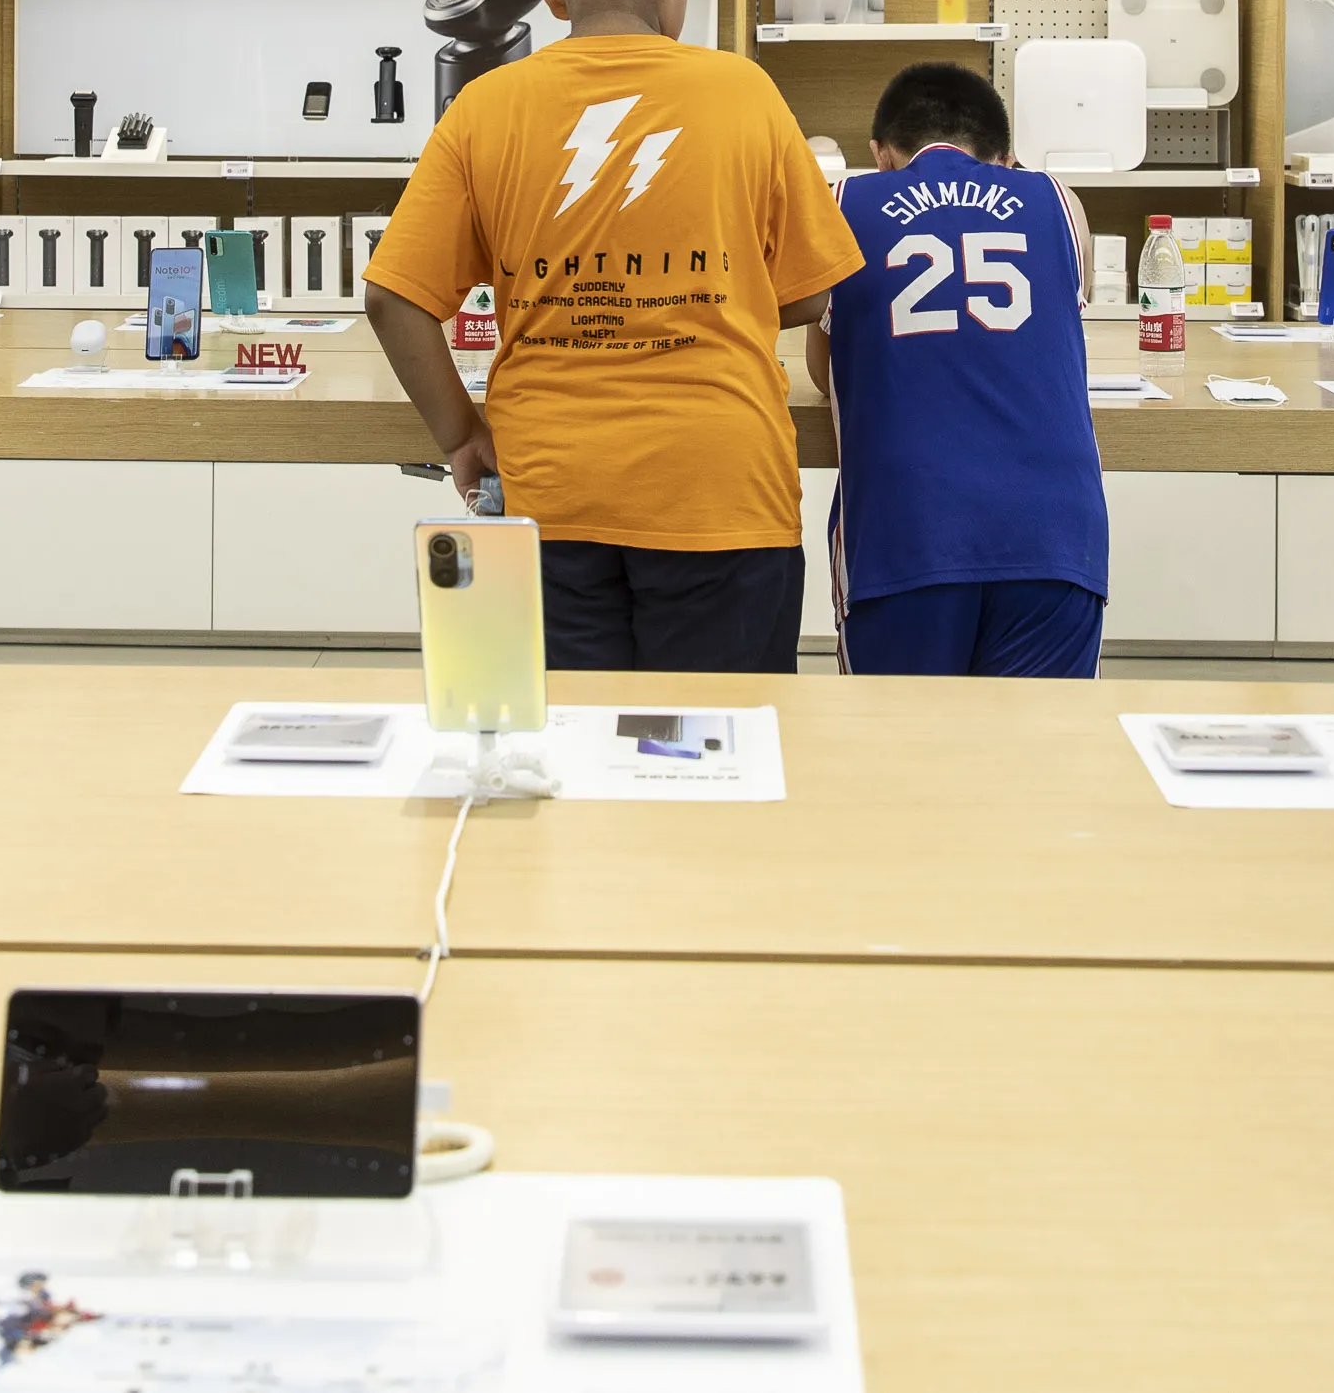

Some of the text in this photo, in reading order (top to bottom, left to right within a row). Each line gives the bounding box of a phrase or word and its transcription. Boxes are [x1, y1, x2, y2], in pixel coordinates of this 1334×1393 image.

[882, 181, 1024, 225] SIMMONS
[572, 281, 625, 293] SUDDENLY
[886, 232, 1032, 337] 25
[577, 295, 632, 308] CRACKLED
[636, 294, 687, 308] THROUGH
[690, 293, 710, 304] THE
[571, 314, 625, 327] LIGHTNING
[581, 328, 616, 340] SWEPT
[550, 337, 569, 348] THE
[572, 339, 604, 350] RIGHT
[605, 342, 629, 350] SIDE
[633, 341, 647, 350] OF
[651, 339, 671, 349] THE
[673, 335, 697, 347] SKY
[237, 344, 303, 365] NEW
